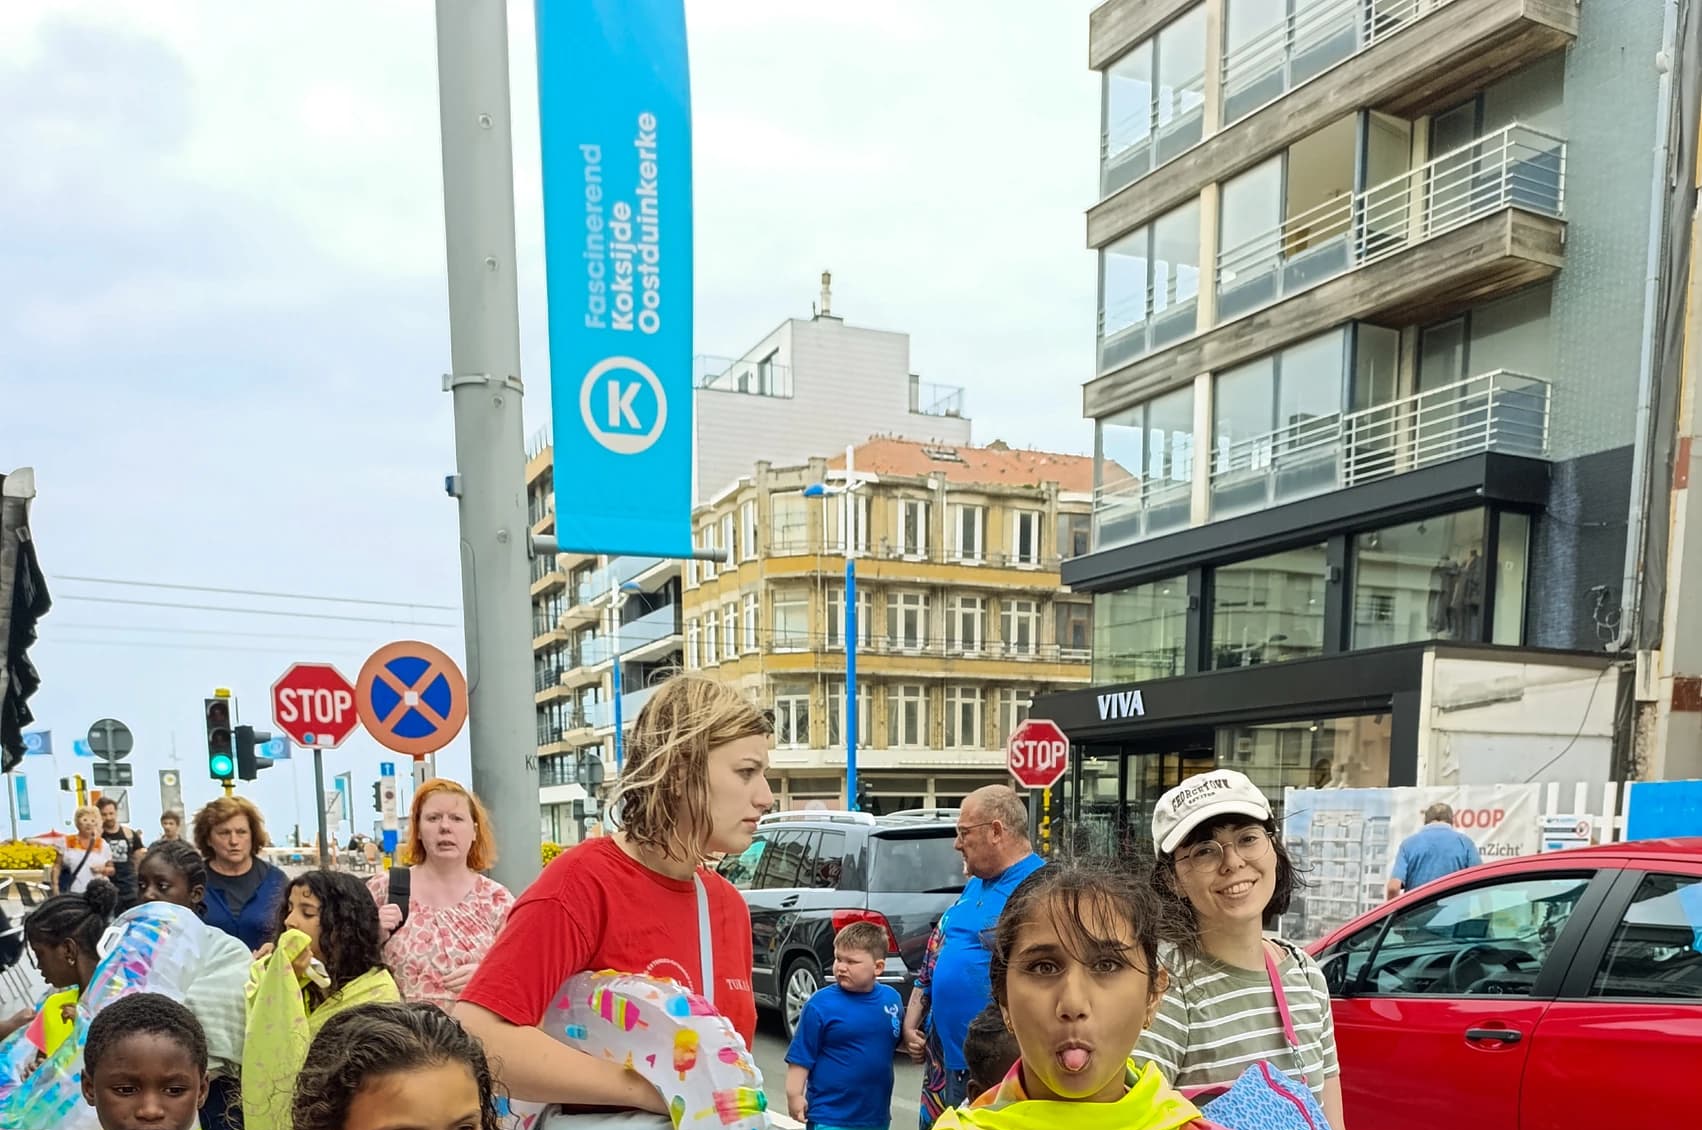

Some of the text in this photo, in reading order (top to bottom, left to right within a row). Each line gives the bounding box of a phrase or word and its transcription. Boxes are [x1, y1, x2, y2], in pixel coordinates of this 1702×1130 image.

[579, 144, 606, 329] Fascinerend
[634, 112, 661, 334] Oostduinkerke
[609, 201, 637, 332] Koksijde
[607, 380, 642, 429] K
[279, 687, 352, 723] STOP
[1097, 690, 1145, 720] VIVA
[1011, 740, 1065, 770] STOP
[1452, 809, 1505, 829] KOOP
